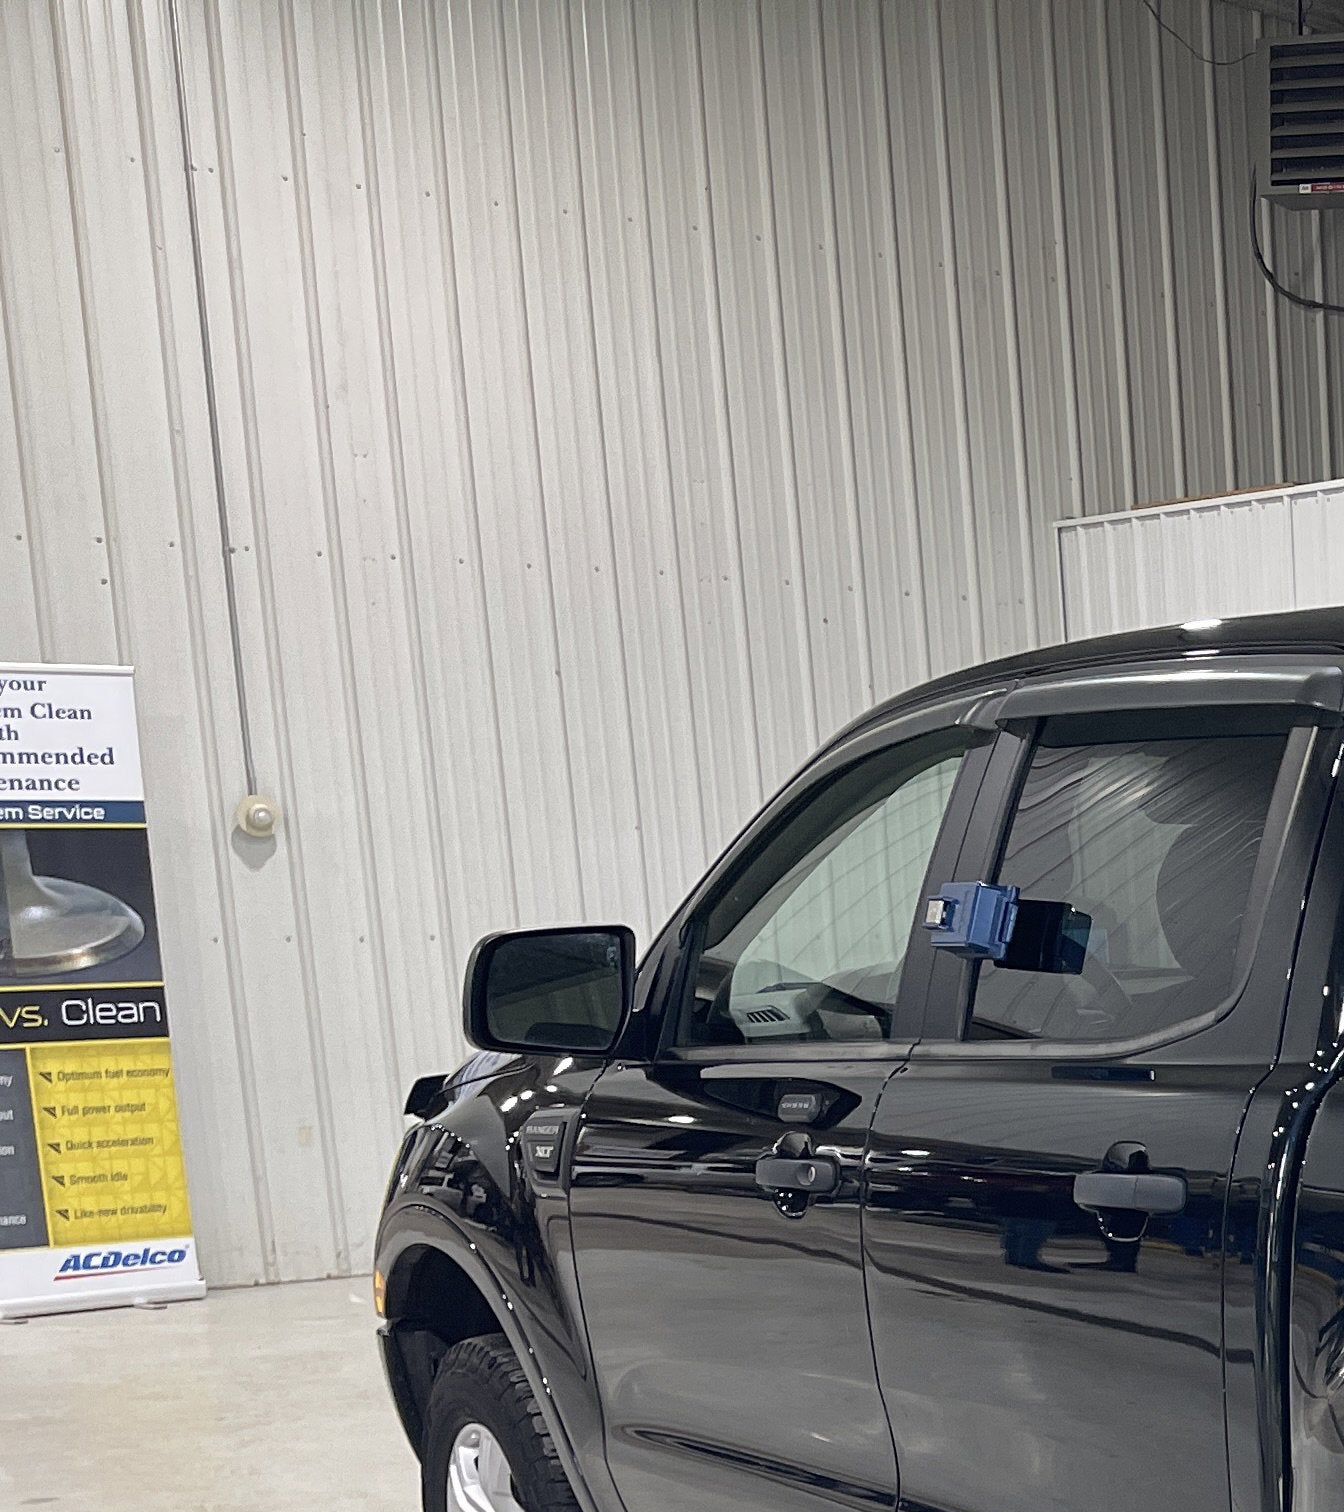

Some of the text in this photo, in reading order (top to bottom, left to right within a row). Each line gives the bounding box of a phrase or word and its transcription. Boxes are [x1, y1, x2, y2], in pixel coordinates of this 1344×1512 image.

[0, 679, 47, 697] your
[30, 702, 92, 720] Clean
[28, 804, 106, 820] Service
[0, 997, 161, 1029] vs. Clean
[57, 1067, 170, 1082] Optimum fuel economy
[61, 1102, 146, 1117] Full power output
[65, 1136, 154, 1152] Quick acceleration
[69, 1171, 128, 1186] Smooth idle
[59, 1247, 188, 1273] ACDelco
